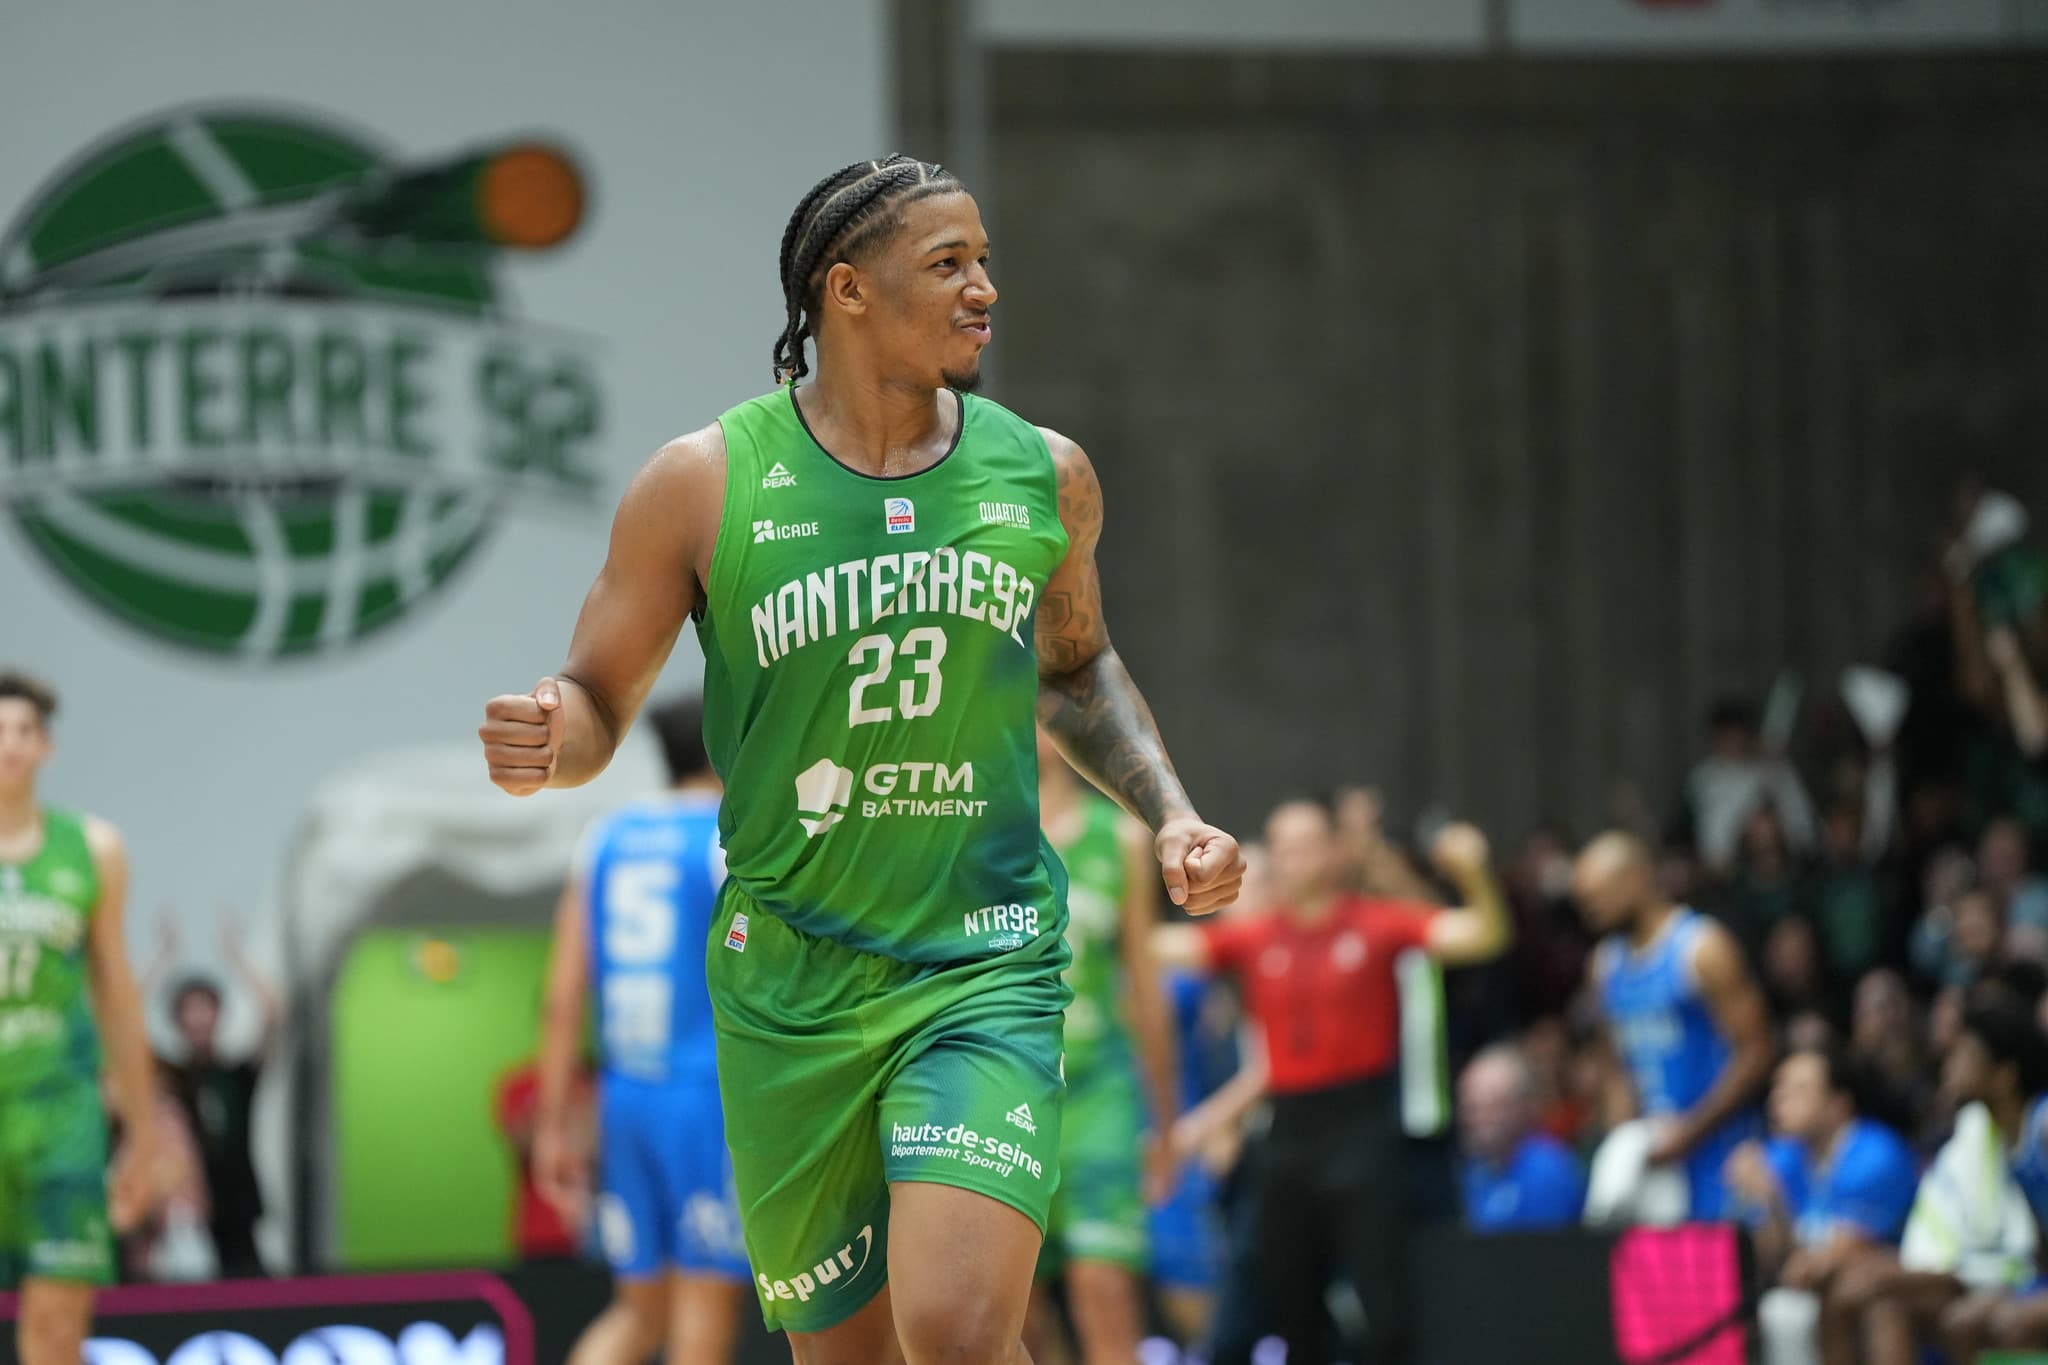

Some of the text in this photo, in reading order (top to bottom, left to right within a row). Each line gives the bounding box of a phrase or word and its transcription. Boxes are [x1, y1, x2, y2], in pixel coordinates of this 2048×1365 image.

[762, 474, 797, 489] PEAK
[979, 502, 1030, 524] QUARTUS
[776, 522, 820, 540] ICADE
[751, 547, 1035, 669] NANTERRE92
[848, 626, 948, 729] 23
[864, 762, 973, 795] GTM
[605, 860, 682, 964] 5
[963, 904, 1039, 937] NTR92
[1005, 1111, 1037, 1137] PEAK
[891, 1143, 1014, 1178] Département Sportif
[892, 1121, 1042, 1180] hauts-de-seine
[758, 1241, 854, 1302] Sepur
